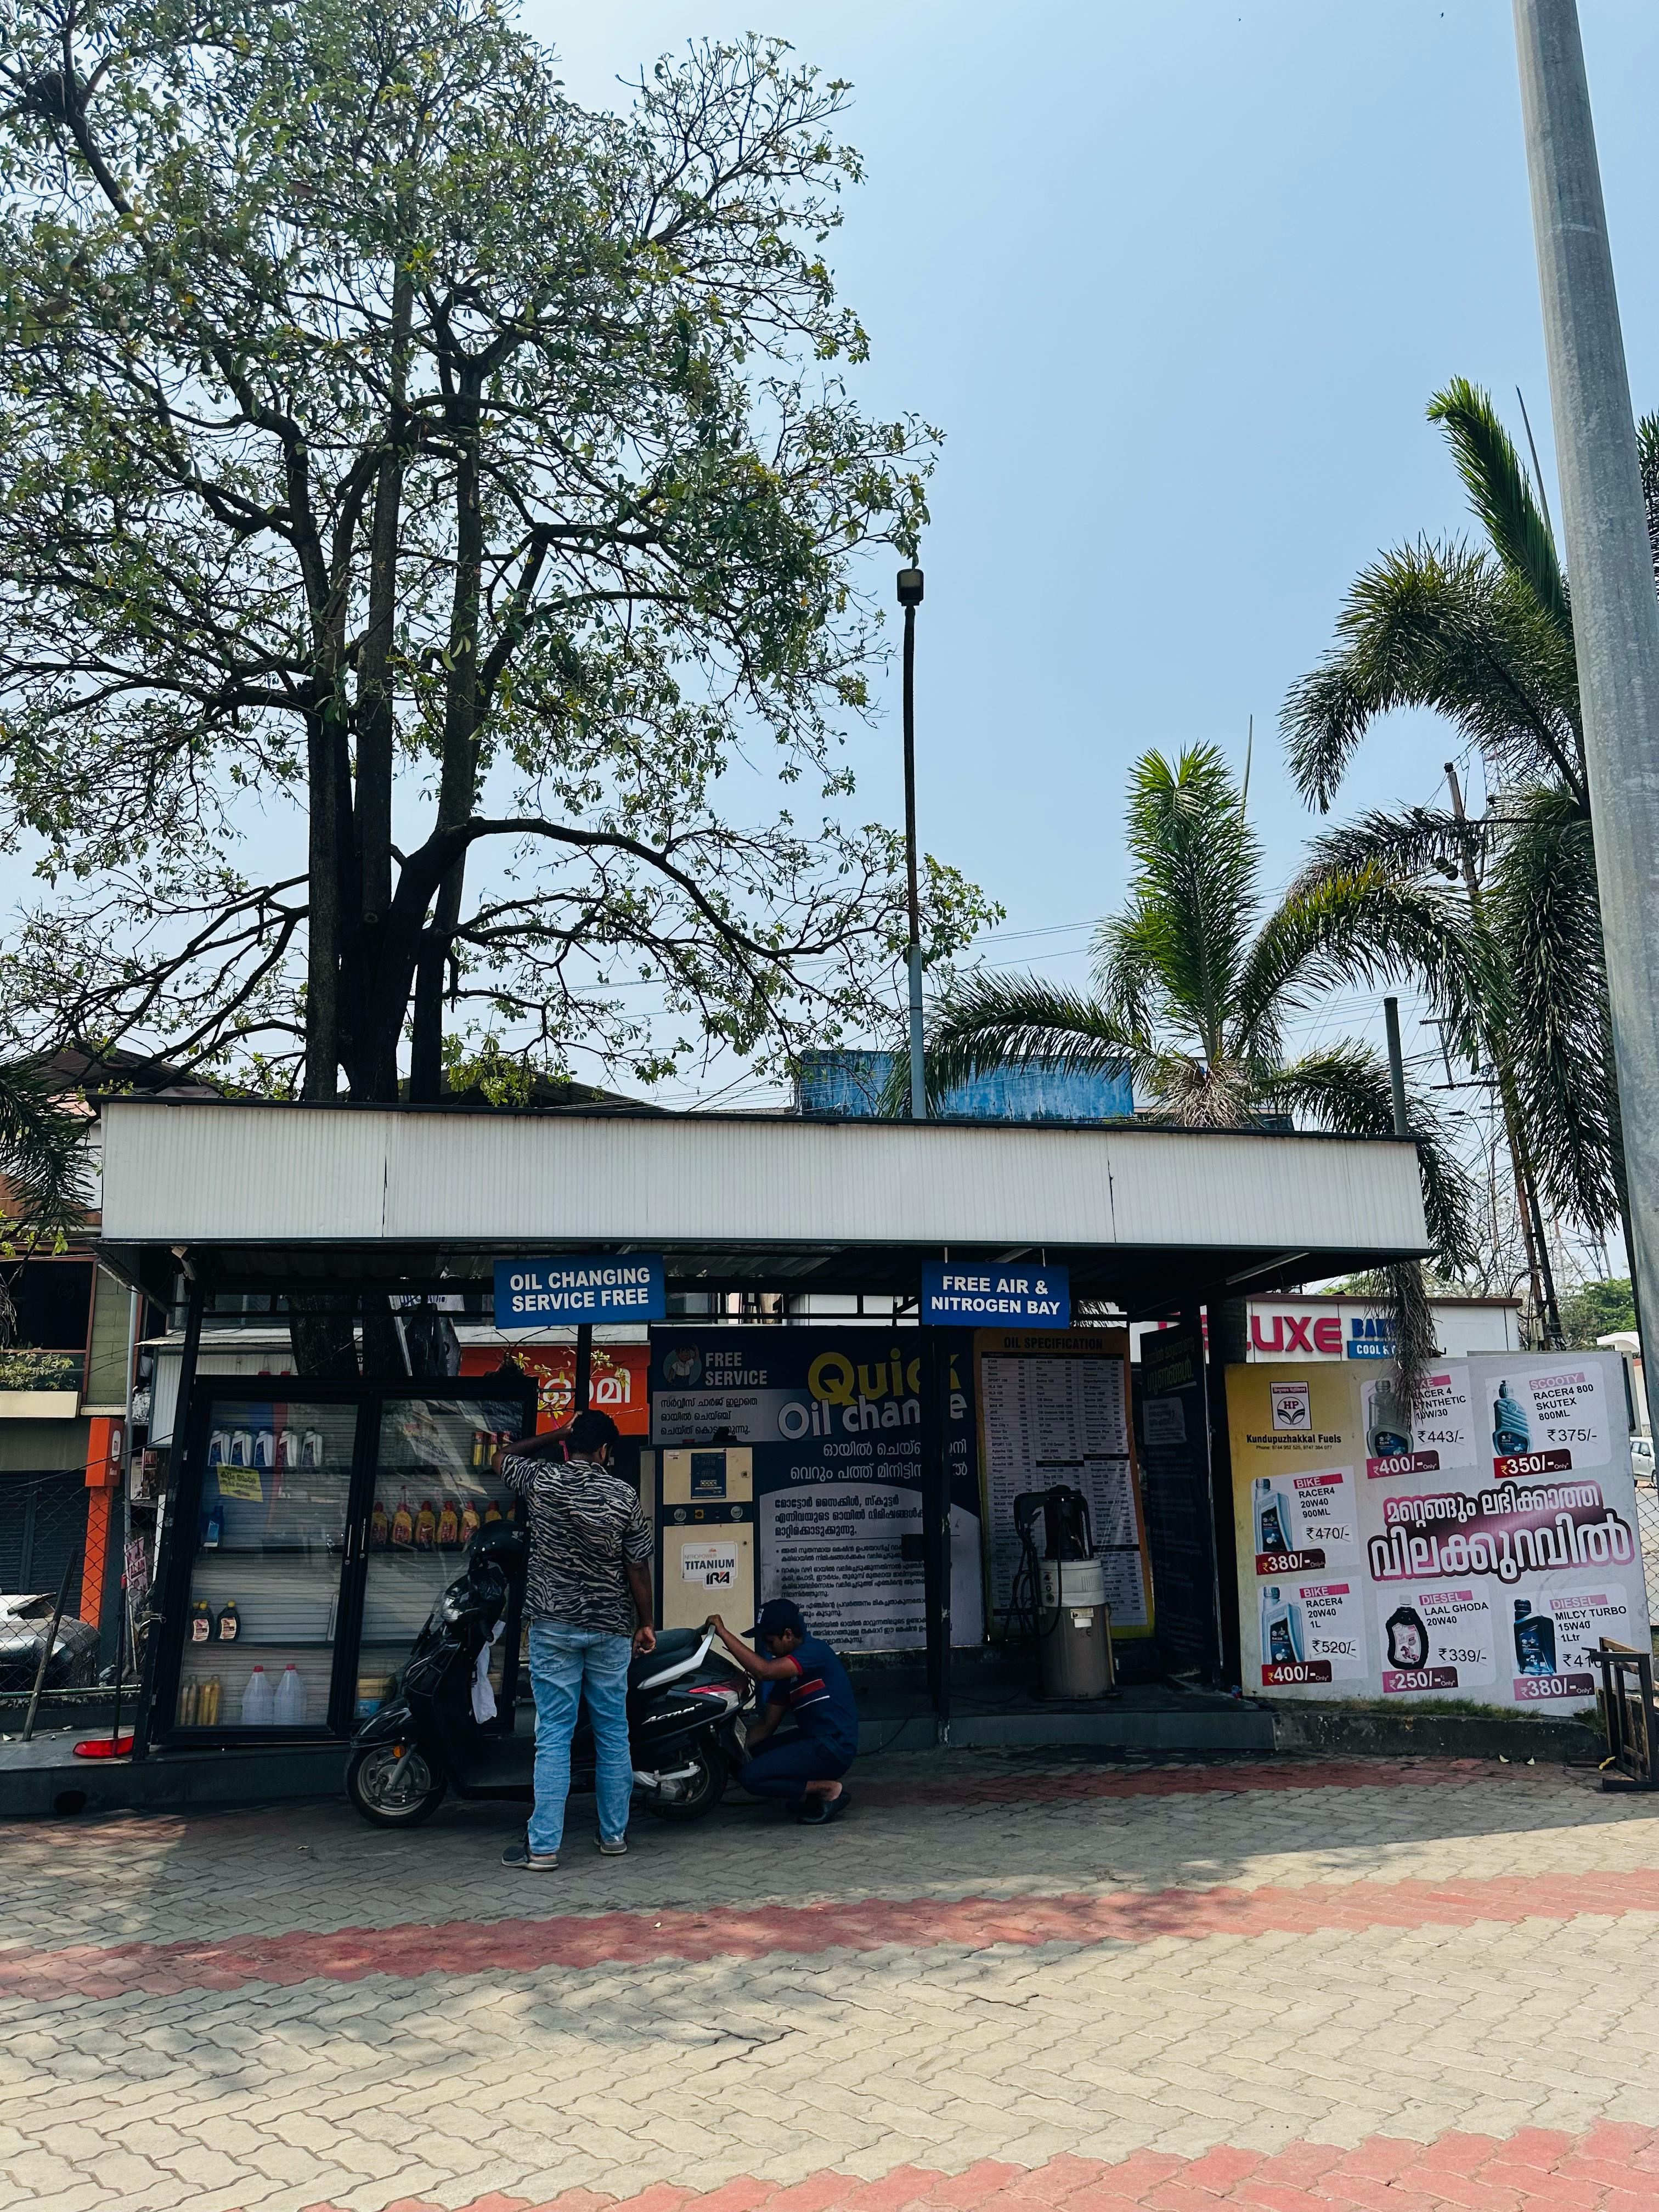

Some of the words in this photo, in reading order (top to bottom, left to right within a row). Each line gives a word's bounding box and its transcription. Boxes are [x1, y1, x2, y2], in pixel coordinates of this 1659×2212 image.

[510, 1273, 543, 1291] OIL
[548, 1267, 650, 1289] CHANGING
[943, 1276, 991, 1292] FREE
[996, 1278, 1029, 1294] AIR
[1035, 1280, 1048, 1295] &
[511, 1293, 595, 1312] SERVICE
[601, 1288, 649, 1307] FREE
[931, 1296, 1021, 1313] NITROGEN
[1026, 1305, 1060, 1315] BAY
[1246, 1316, 1343, 1352] UXE
[1004, 1337, 1021, 1348] OIL
[1024, 1338, 1103, 1350] SPECIFICATION
[1356, 1345, 1381, 1355] COOL
[706, 1352, 742, 1367] FREE
[705, 1370, 768, 1386] SERVICE
[1531, 1374, 1579, 1390] SCOOTY
[1533, 1387, 1575, 1400] RACER4
[1576, 1384, 1594, 1393] 800
[1283, 1401, 1299, 1409] HP
[1536, 1397, 1577, 1410] SKUTEX
[661, 1412, 692, 1421] ഓയിൽ
[778, 1399, 832, 1440] Oil
[842, 1393, 967, 1432] chane
[1538, 1409, 1571, 1420] 800ML
[661, 1426, 693, 1435] ചെയ്ത്
[1246, 1434, 1315, 1444] Kundupuzhakkal
[1318, 1434, 1341, 1443] Fuels
[823, 1441, 872, 1457] ഓയിൽ
[1373, 1455, 1423, 1476] ₹400/-
[1500, 1454, 1554, 1475] ₹350/-
[791, 1465, 833, 1482] വെറും
[838, 1463, 874, 1479] പത്ത്
[1296, 1477, 1322, 1488] BIKE
[1299, 1487, 1335, 1498] RACER4
[775, 1497, 812, 1509] മോട്ടോർ
[1300, 1498, 1329, 1508] 20W40
[1387, 1497, 1476, 1528] മറ്റെങ്ങും
[1482, 1485, 1600, 1515] ലഭിക്കാത്ത
[775, 1510, 830, 1523] എന്നിവയുടെ
[832, 1509, 866, 1520] ഓയിൽ
[1302, 1508, 1331, 1518] 900ML
[1370, 1512, 1630, 1580] വിലക്കുറവിൽ
[685, 1559, 735, 1570] TITANIUM
[1262, 1553, 1311, 1572] ₹380/-
[706, 1571, 730, 1585] IRA
[1303, 1586, 1329, 1598] BIKE
[1421, 1592, 1463, 1605] DIESEL
[1306, 1597, 1343, 1608] RACER4
[1425, 1606, 1451, 1616] LAAL
[1452, 1602, 1489, 1612] GHODA
[1552, 1596, 1596, 1610] DIESEL
[1308, 1609, 1336, 1618] 20W40
[1555, 1610, 1586, 1620] MILCY
[1589, 1606, 1627, 1617] TURBO
[1427, 1616, 1457, 1626] 20W40
[1558, 1620, 1590, 1631] 15W40
[1561, 1634, 1580, 1642] 1Ltr
[1268, 1666, 1316, 1683] ₹400/-
[1389, 1671, 1441, 1690] ₹250/-
[1520, 1677, 1576, 1697] ₹380/-
